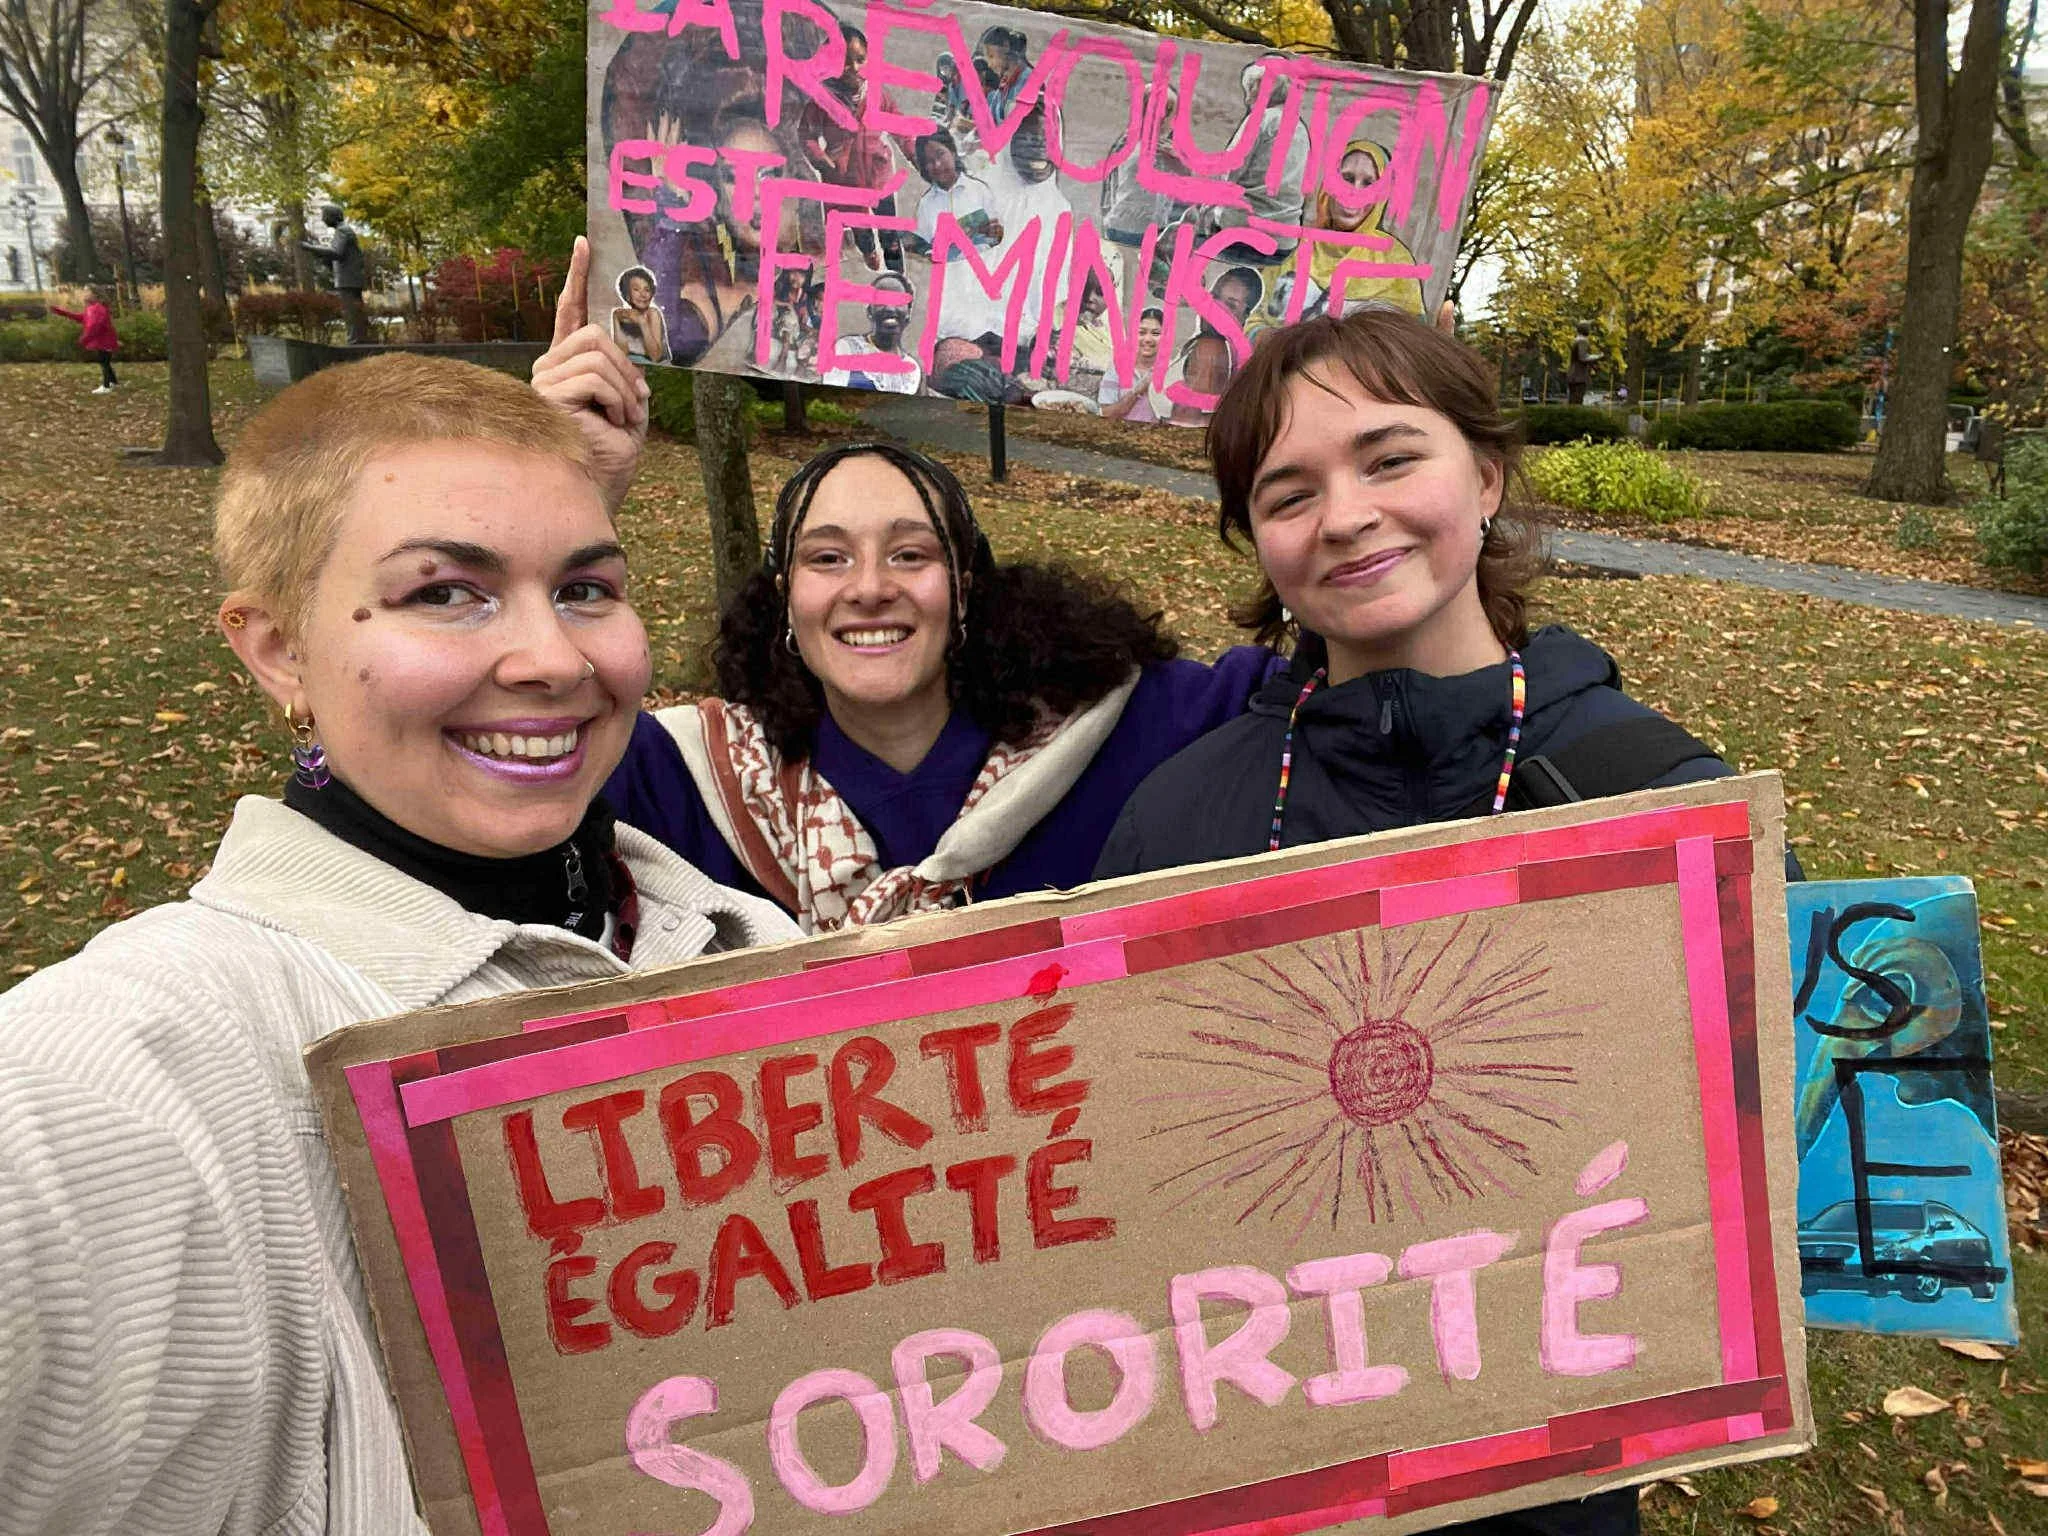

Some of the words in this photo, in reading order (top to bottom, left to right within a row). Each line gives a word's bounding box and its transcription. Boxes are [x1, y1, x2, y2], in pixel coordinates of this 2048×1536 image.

[608, 139, 786, 223] EST
[762, 0, 1490, 232] RÉVOLUTION
[564, 912, 583, 928] THE
[503, 962, 1096, 1240] LIBERTÉ
[546, 1106, 1118, 1356] ÉGALITÉ
[624, 1140, 1652, 1536] SORORITÉ
